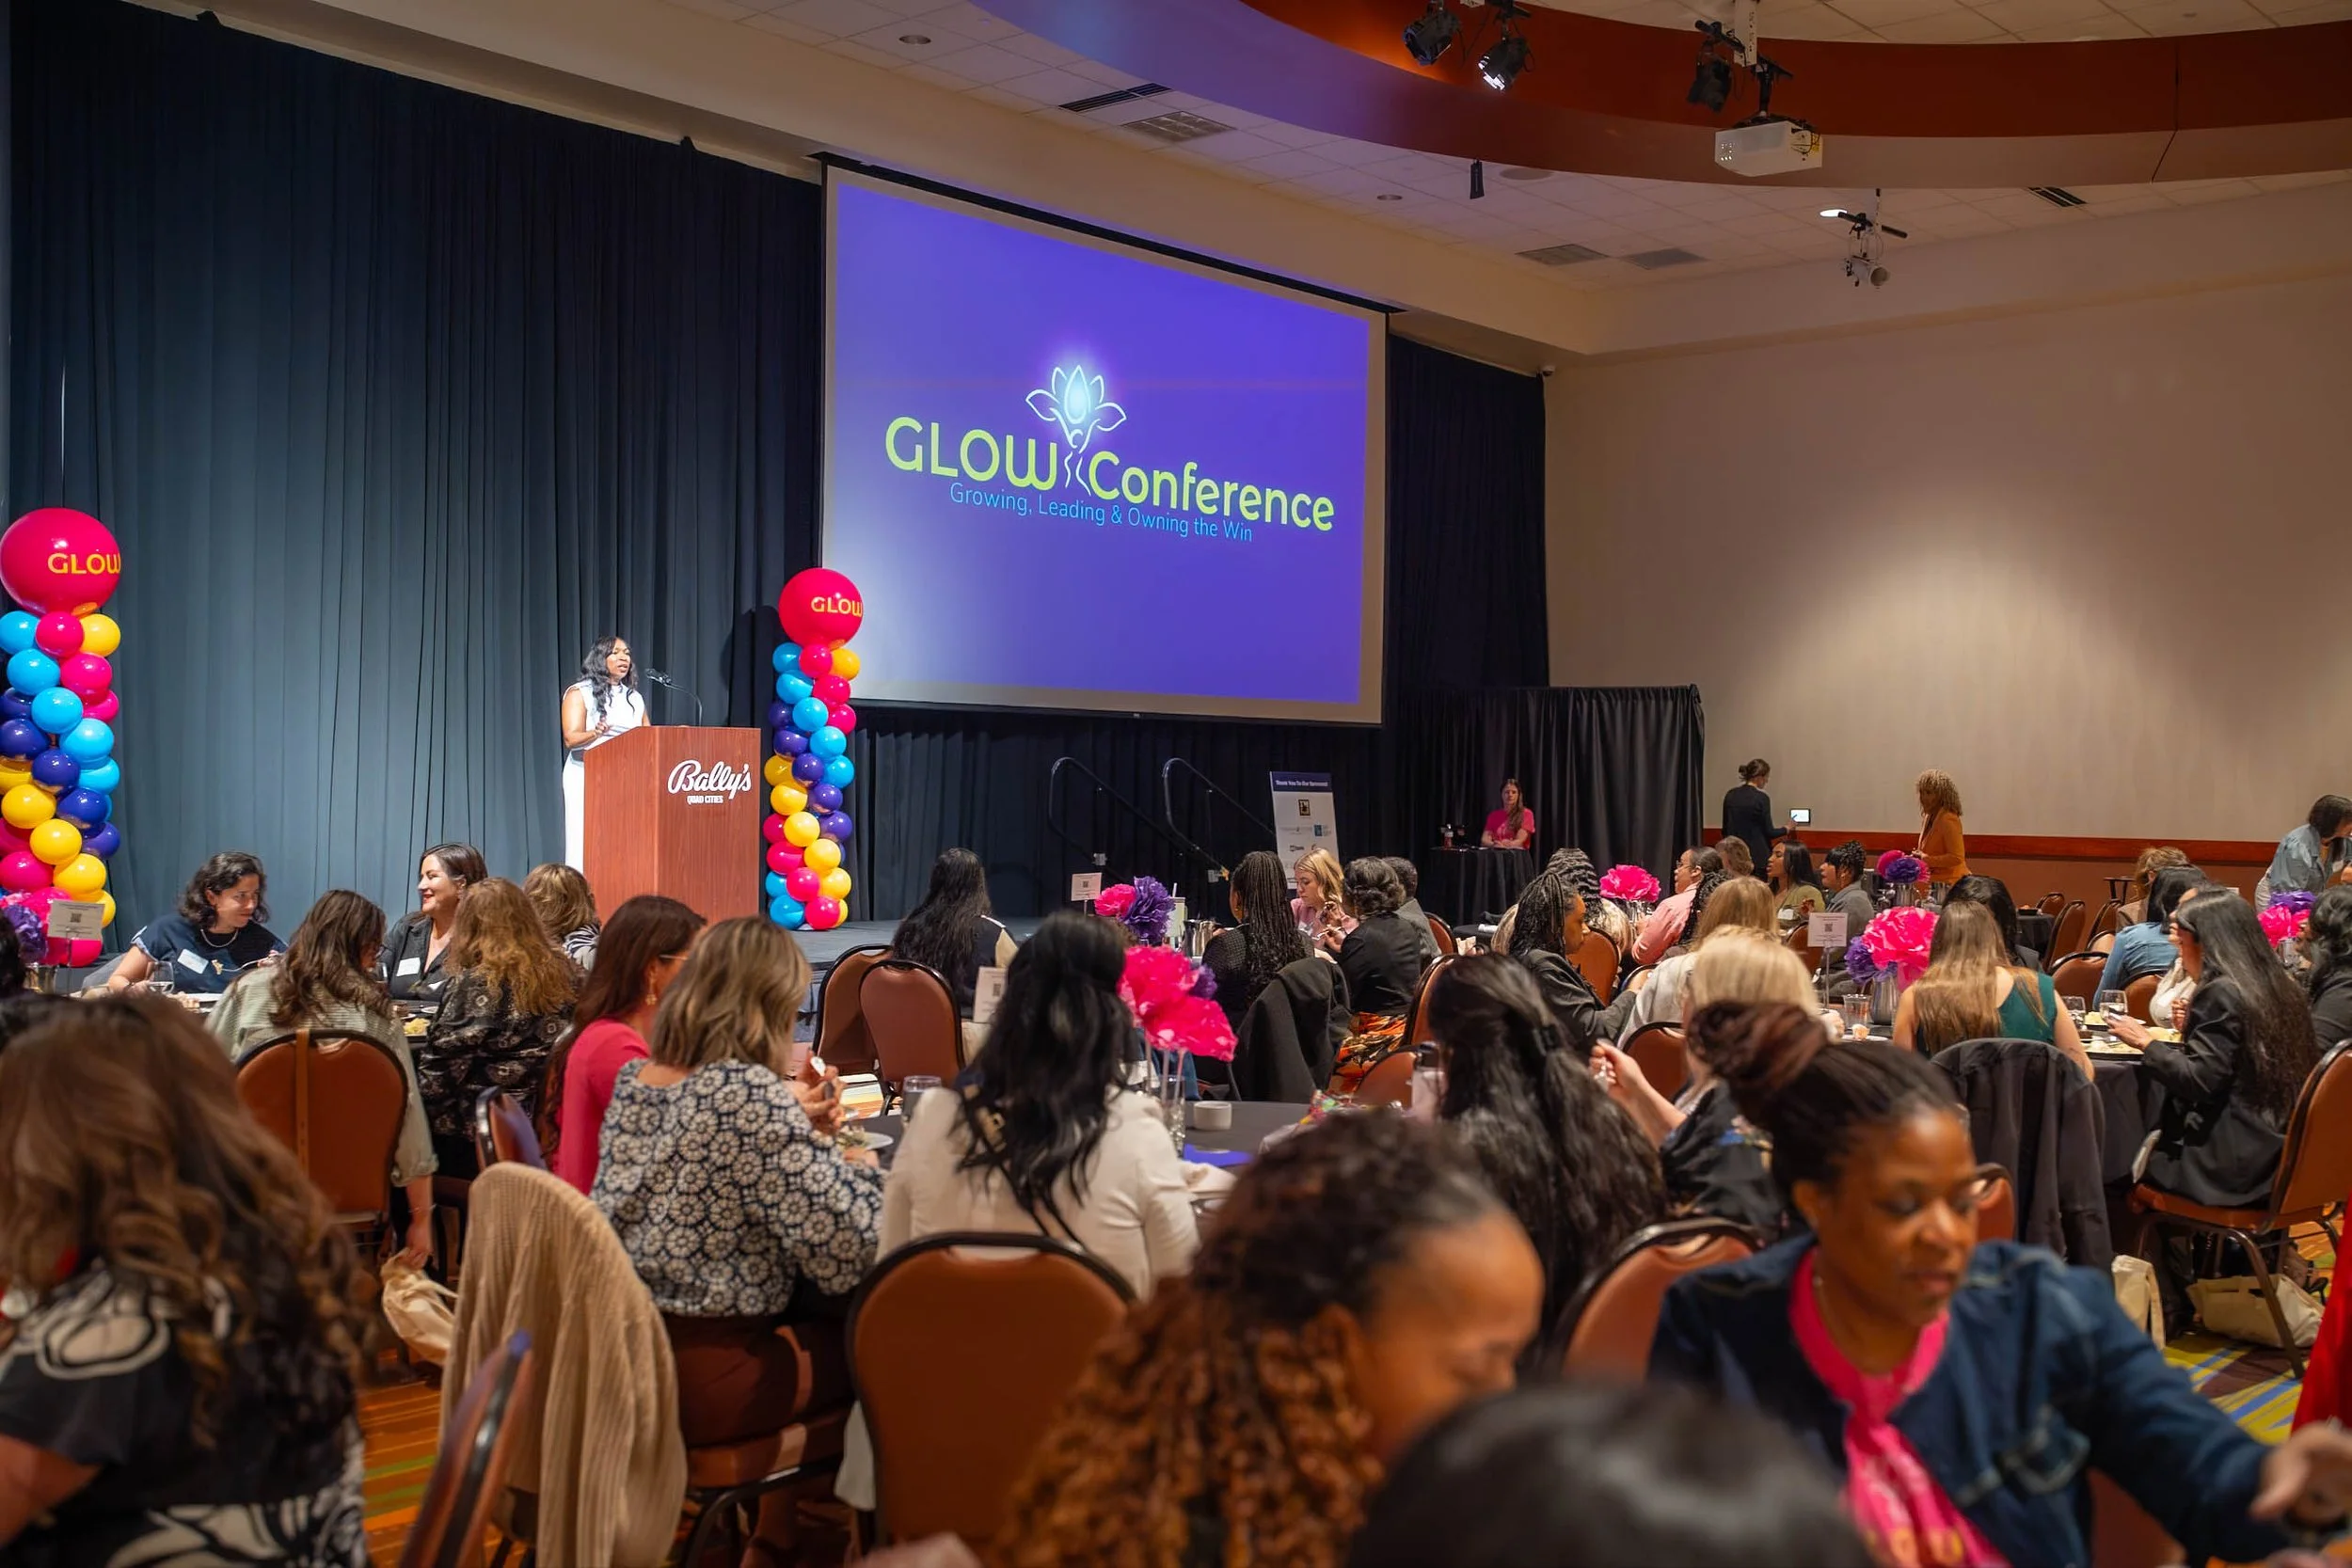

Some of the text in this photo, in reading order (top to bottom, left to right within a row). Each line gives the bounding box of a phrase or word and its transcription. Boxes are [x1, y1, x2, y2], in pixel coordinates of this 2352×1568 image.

[885, 416, 1335, 531] GLOW Conference
[950, 482, 1252, 543] Growing, Leading & Owning the Win
[47, 552, 121, 574] GLOW
[810, 596, 863, 618] GLOW
[667, 759, 752, 800] Bally's
